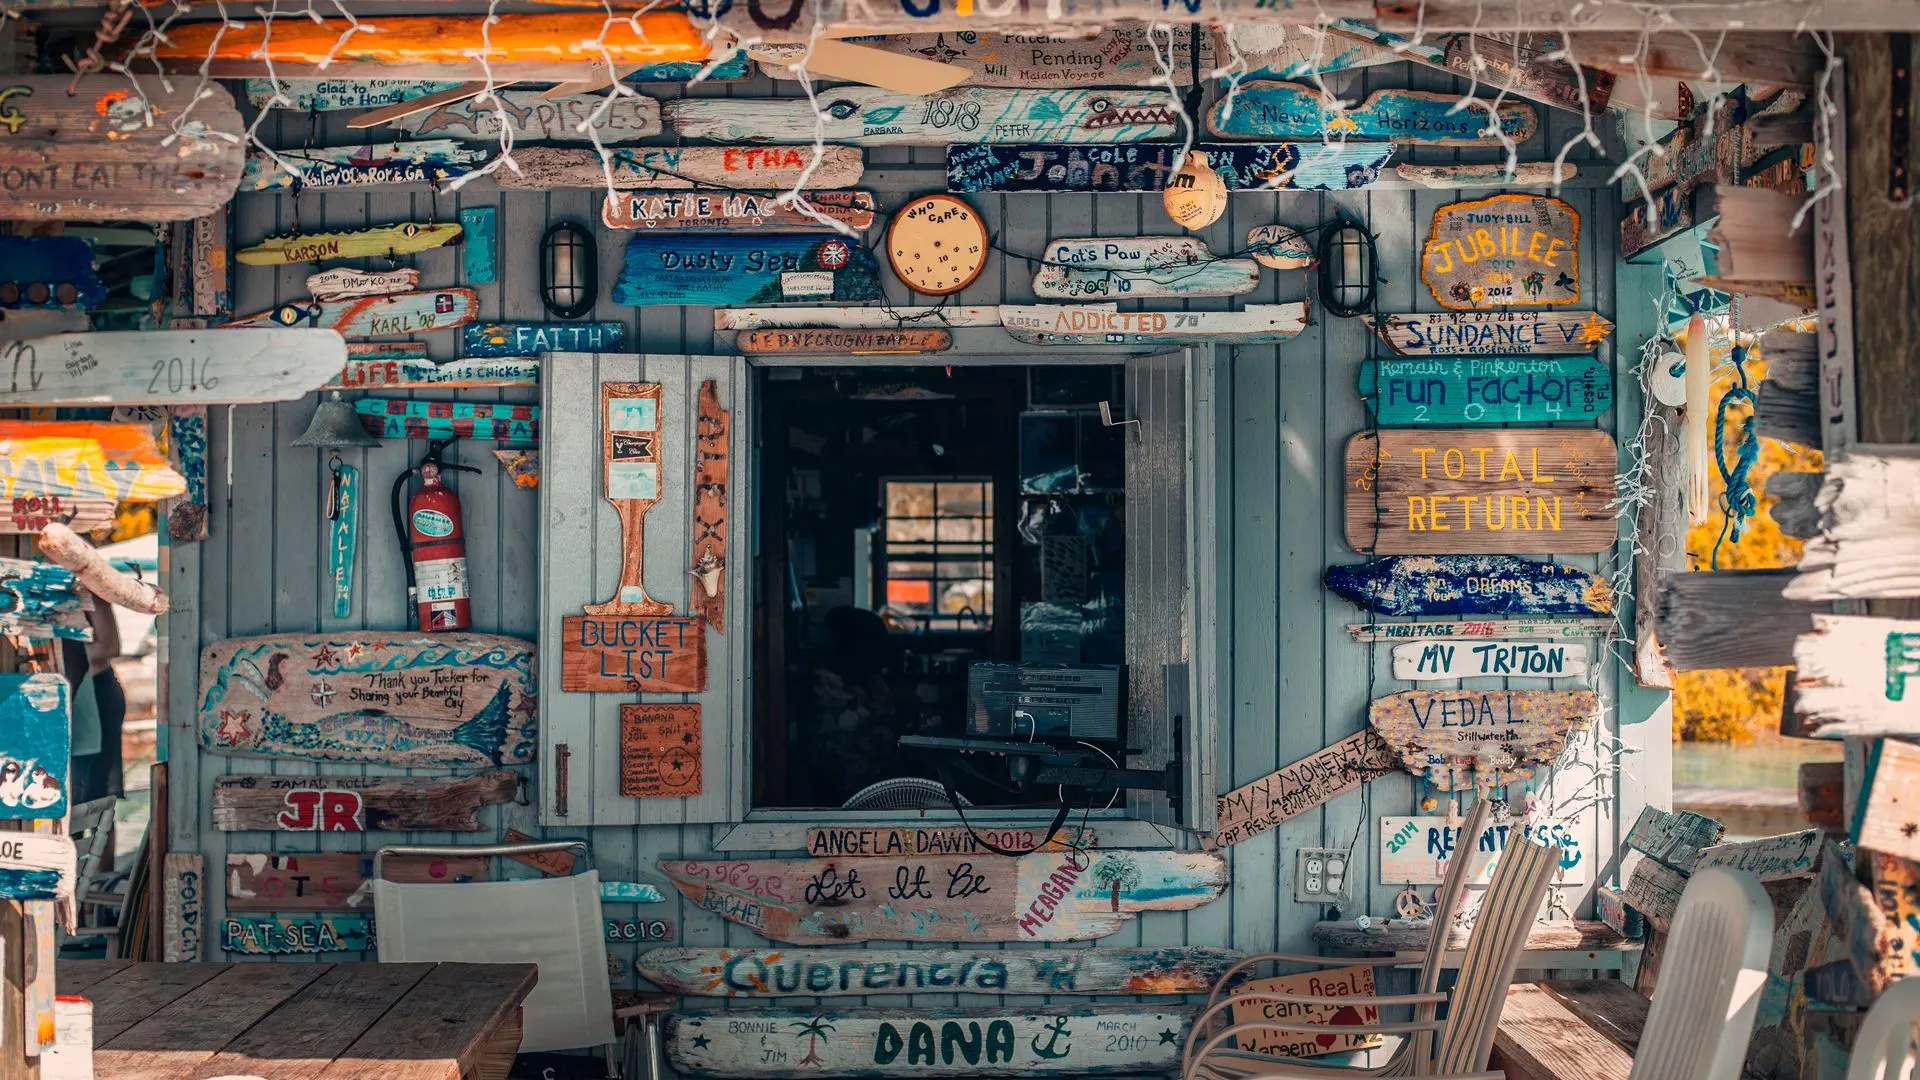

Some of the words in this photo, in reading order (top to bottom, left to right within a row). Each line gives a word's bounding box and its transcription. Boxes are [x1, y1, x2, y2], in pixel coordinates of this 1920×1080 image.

[984, 63, 1008, 77] Will
[1032, 49, 1102, 70] Pending
[316, 82, 347, 95] Glad
[352, 83, 367, 95] to
[339, 94, 354, 107] be
[920, 99, 981, 132] 1818
[1262, 104, 1308, 125] New
[1377, 111, 1468, 132] Horizons
[863, 125, 904, 136] BARBARA
[995, 124, 1031, 137] PETER
[1088, 147, 1139, 163] COLE
[630, 197, 712, 221] KATIE
[908, 201, 935, 220] WHO
[928, 207, 968, 224] CARES
[678, 217, 730, 228] TORONTO
[285, 241, 340, 262] KARSON
[938, 254, 949, 263] 10
[968, 245, 979, 255] 12
[1057, 245, 1098, 265] Cat's
[1104, 243, 1141, 261] Paw
[1150, 241, 1173, 263] Mac
[1433, 226, 1566, 273] JUBILEE
[659, 249, 735, 272] Dusty
[744, 248, 800, 274] Sea
[904, 266, 915, 276] 11
[319, 274, 339, 284] 2016
[1487, 286, 1513, 297] 2012
[371, 315, 412, 337] KARL
[1055, 310, 1168, 333] ADDICTED
[516, 327, 603, 352] FAITH
[1405, 319, 1549, 349] SUNDANCE
[1556, 322, 1581, 344] V
[1468, 343, 1532, 355] ROSEMARY
[147, 356, 219, 396] 2016
[427, 370, 453, 383] Lori
[1470, 358, 1565, 377] Pinkerton
[1388, 377, 1446, 406] Fun
[1466, 375, 1585, 407] Factor
[1597, 383, 1610, 401] FL
[1410, 446, 1556, 484] TOTAL
[12, 495, 64, 516] ROLL
[1406, 495, 1563, 532] RETURN
[336, 473, 352, 582] NATALIE
[1466, 576, 1534, 595] DREAMS
[580, 619, 692, 649] BUCKET
[1385, 623, 1455, 638] HERITAGE
[600, 649, 674, 680] LIST
[1416, 643, 1456, 674] MV
[1472, 643, 1565, 675] TRITON
[363, 671, 407, 690] Thank
[410, 674, 430, 691] you
[430, 668, 469, 686] Tucker
[471, 668, 490, 684] for
[349, 686, 390, 707] Sharing
[395, 689, 420, 706] your
[444, 696, 465, 718] Cay
[633, 713, 676, 725] BANANA
[1407, 694, 1496, 730] VEDA
[1506, 694, 1531, 725] L.
[658, 724, 681, 739] Split
[1426, 754, 1446, 766] Bob
[1488, 754, 1518, 770] Buddy
[270, 778, 328, 790] JAMAL
[336, 775, 384, 790] ROLLE
[276, 788, 364, 832] JR
[812, 830, 908, 854] ANGELA
[916, 830, 977, 855] DAWN
[987, 831, 1035, 850] 2012
[1215, 825, 1241, 849] CAP
[1385, 820, 1421, 855] 2014
[804, 866, 866, 905] Let
[888, 864, 932, 900] It
[945, 862, 991, 900] Be
[1018, 855, 1084, 939] MEAGAN
[227, 921, 335, 948] PAT-SEA
[1308, 972, 1362, 997] Real
[728, 1020, 779, 1035] BONNIE
[1096, 1019, 1137, 1033] MARCH
[873, 1020, 1017, 1067] DANA
[1105, 1034, 1149, 1053] 2010
[759, 1050, 788, 1064] JIM
